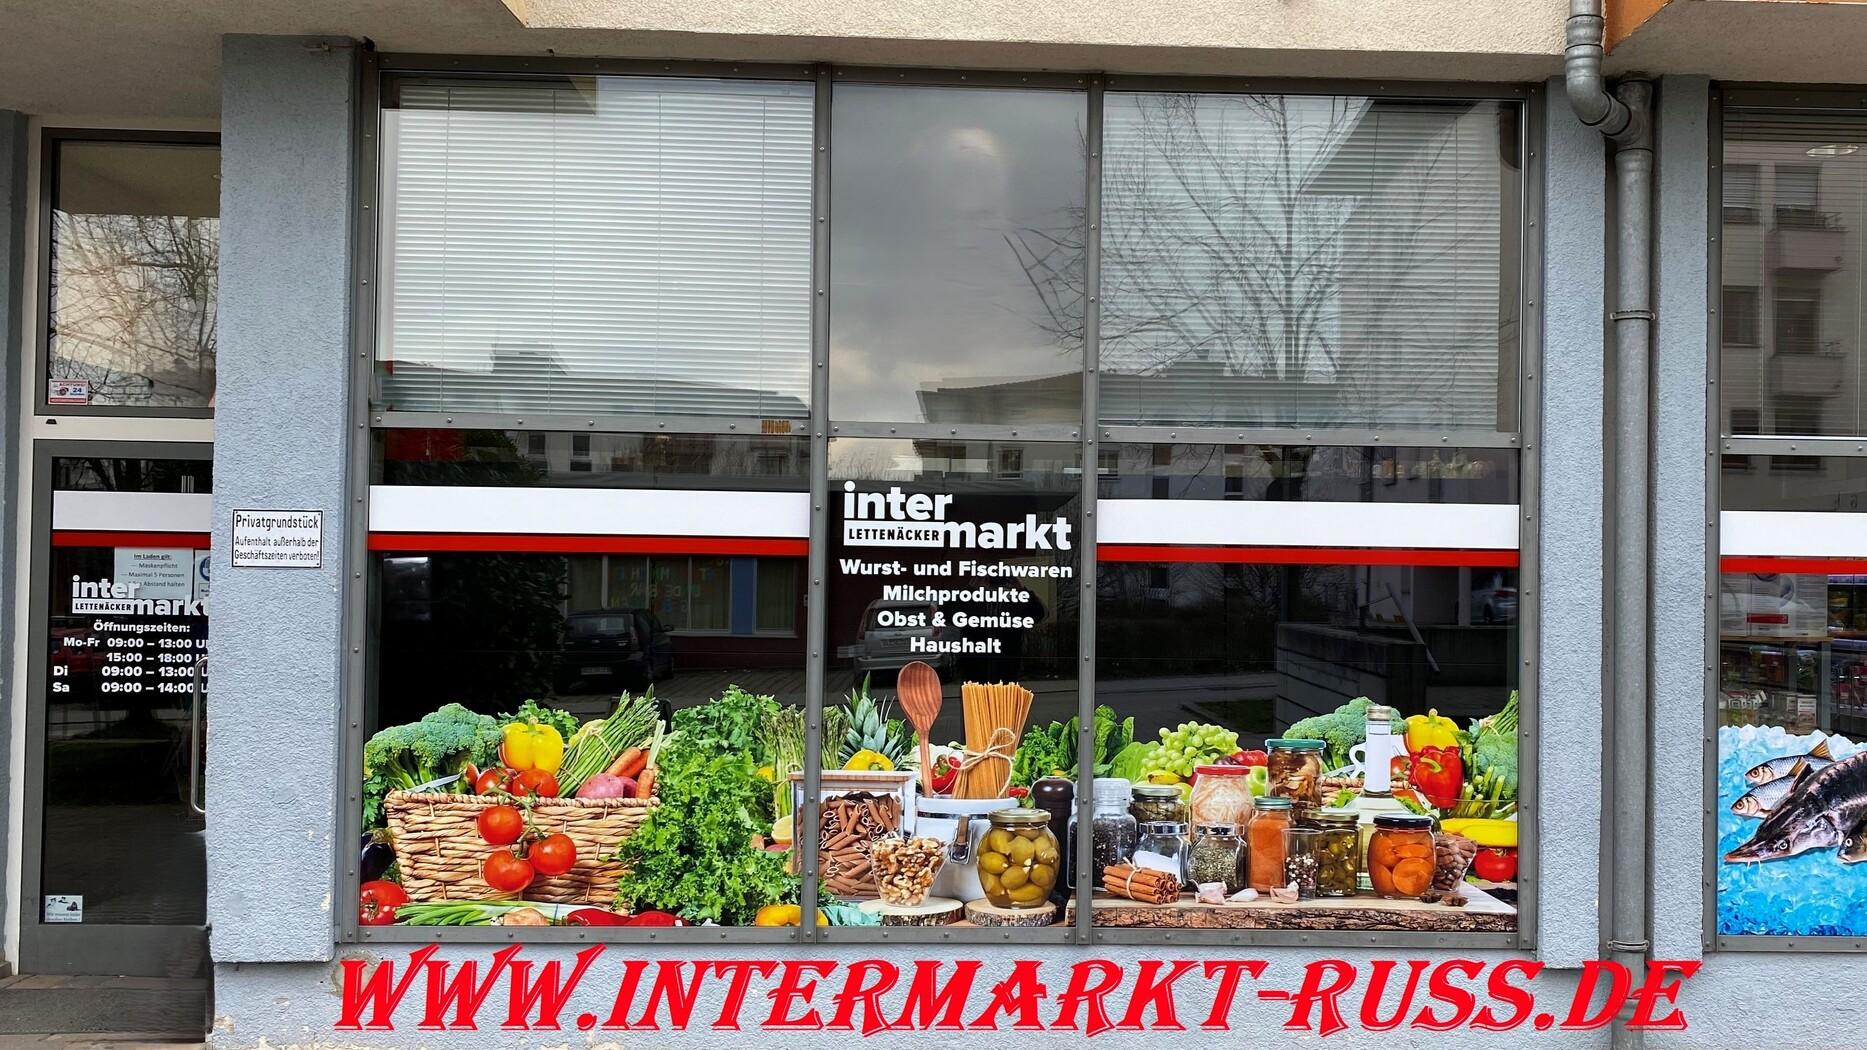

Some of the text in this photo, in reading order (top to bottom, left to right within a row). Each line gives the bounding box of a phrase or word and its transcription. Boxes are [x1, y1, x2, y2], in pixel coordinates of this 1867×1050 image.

[844, 481, 953, 520] inter
[235, 514, 319, 531] Privatgrundstück
[848, 514, 1072, 550] LETTENÄCKER markt
[235, 536, 319, 547] Aufenthalt außerhalb der
[234, 549, 320, 560] Geschäftszeiten verboten!
[839, 558, 1073, 578] Wurst- und Fischwaren
[72, 574, 140, 598] inter
[882, 584, 1030, 605] Milchprodukte
[75, 601, 132, 611] LETTENÄCKER
[93, 619, 190, 634] Öffnungszeiten:
[877, 610, 1035, 628] Obst & Gemüse
[63, 637, 100, 647] Mo-Fr
[107, 638, 144, 647] 09:00
[158, 638, 192, 648] 13:00
[910, 636, 1002, 653] Haushalt
[106, 652, 143, 662] 15:00
[157, 653, 192, 663] 18:00
[53, 665, 68, 676] Di
[101, 666, 142, 676] 09:00
[158, 666, 194, 677] 13:00
[52, 682, 70, 692] Sa
[101, 682, 142, 692] 09:00
[157, 682, 193, 693] 14:00
